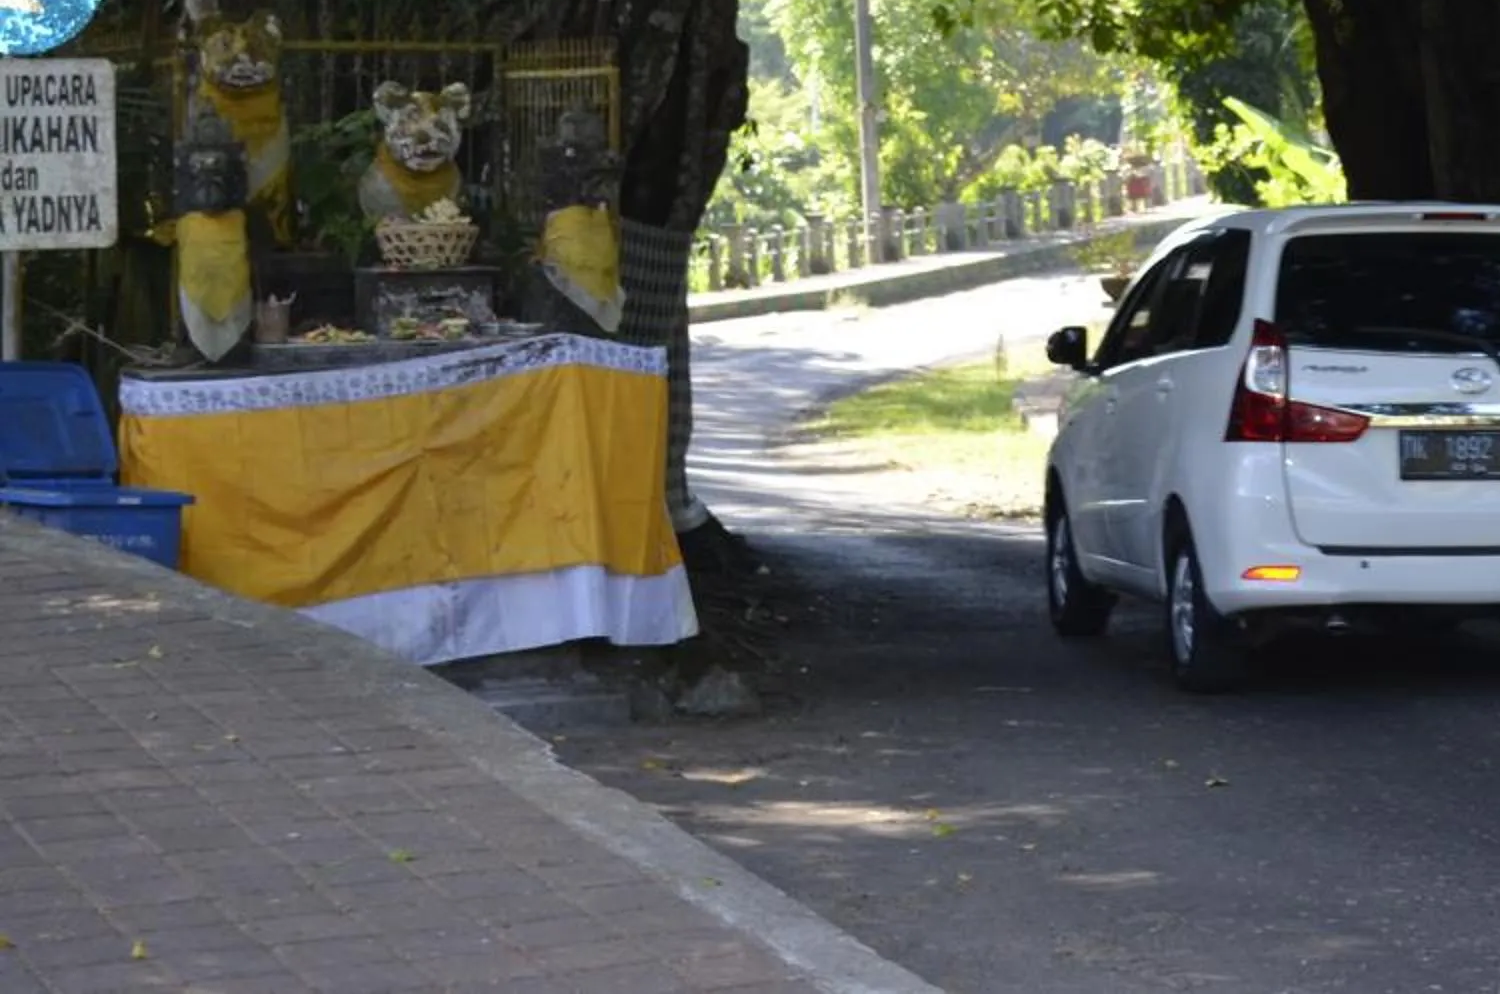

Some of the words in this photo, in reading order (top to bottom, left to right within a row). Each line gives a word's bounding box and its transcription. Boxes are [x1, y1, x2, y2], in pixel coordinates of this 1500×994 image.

[5, 74, 97, 106] UPACARA
[2, 159, 39, 191] dan
[13, 195, 102, 234] YADNYA
